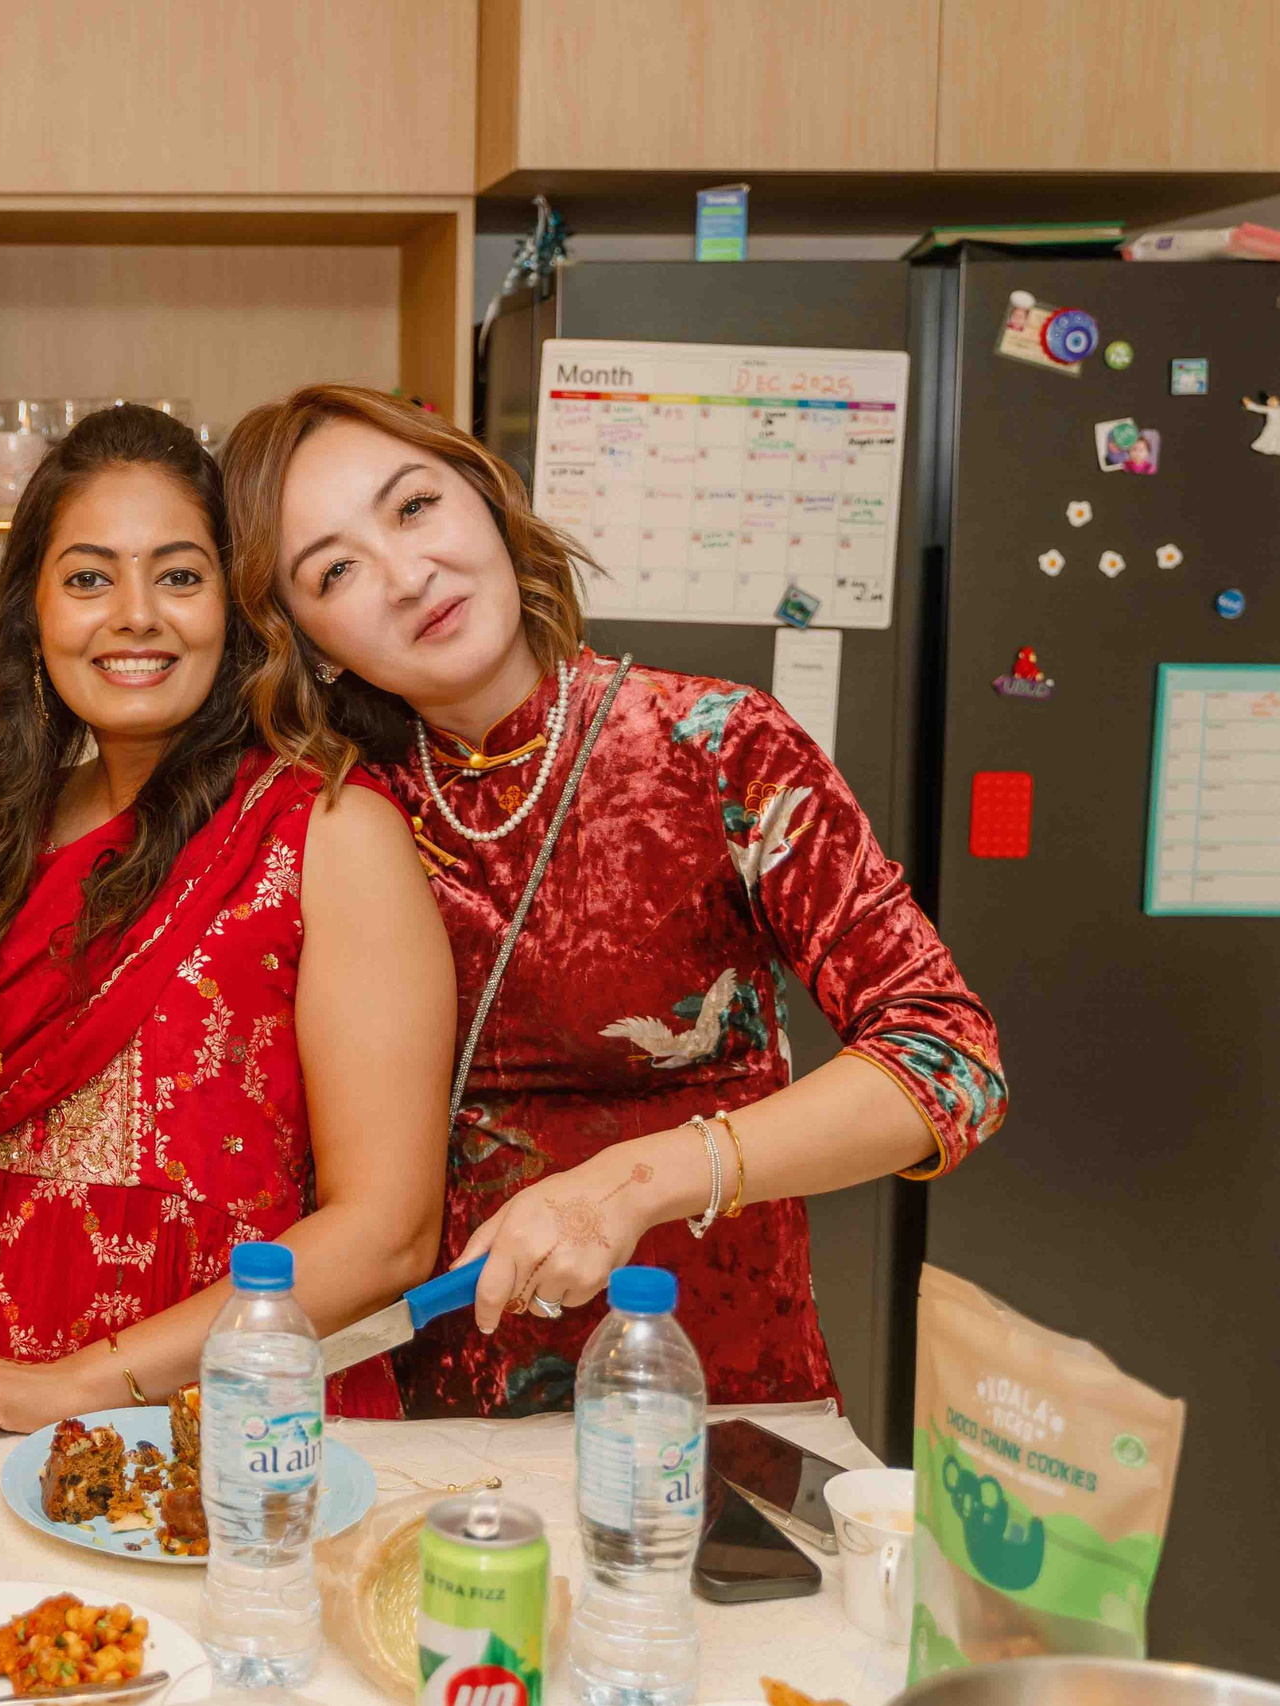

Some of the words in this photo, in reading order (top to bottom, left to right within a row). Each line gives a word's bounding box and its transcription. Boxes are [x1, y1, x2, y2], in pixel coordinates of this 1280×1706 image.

[557, 363, 633, 386] Month
[733, 367, 782, 393] DEC
[789, 371, 855, 400] 2025
[249, 1446, 280, 1473] al
[286, 1440, 322, 1472] ain
[946, 1406, 978, 1439] CHOCO
[981, 1427, 1021, 1463] CHUNK
[1027, 1450, 1098, 1492] COOKIES
[470, 1586, 506, 1601] FIZZ
